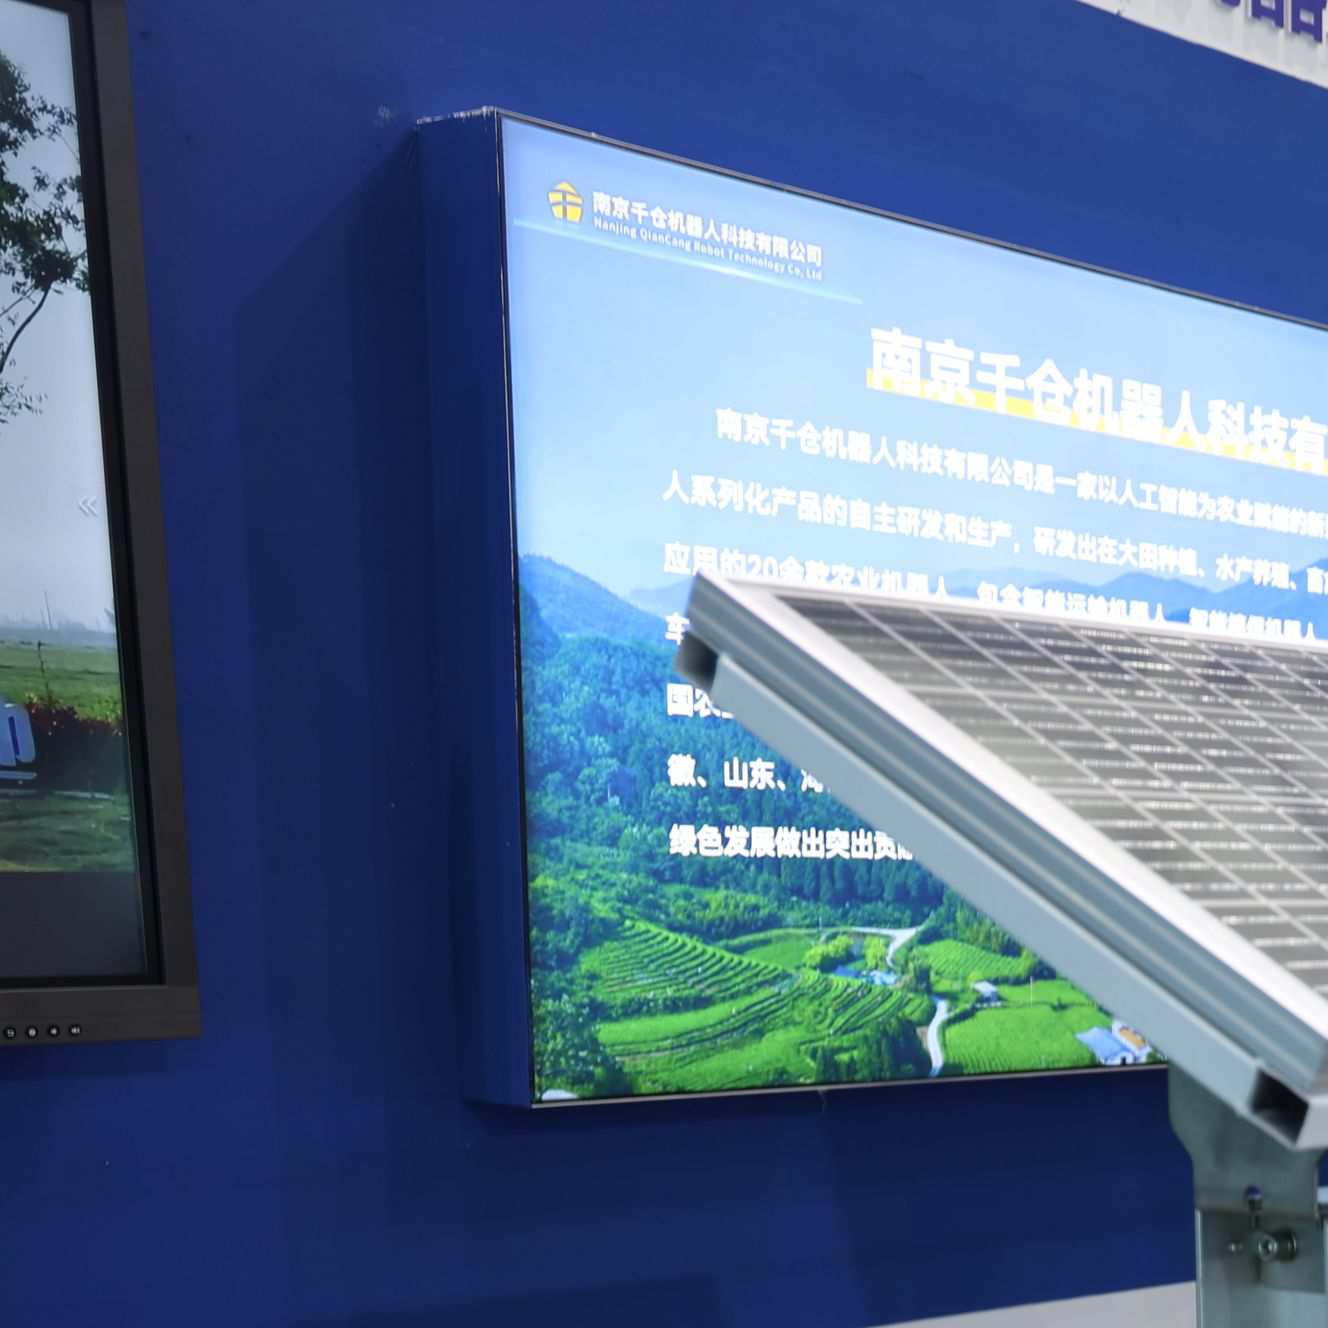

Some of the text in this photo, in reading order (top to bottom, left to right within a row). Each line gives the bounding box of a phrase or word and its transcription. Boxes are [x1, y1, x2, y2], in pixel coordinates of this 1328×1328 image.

[592, 191, 823, 267] 南京千仓机器人科技有限公司
[593, 216, 637, 239] Nanjing
[640, 230, 692, 253] QianCang
[694, 239, 725, 258] Robot
[728, 250, 785, 273] Technology
